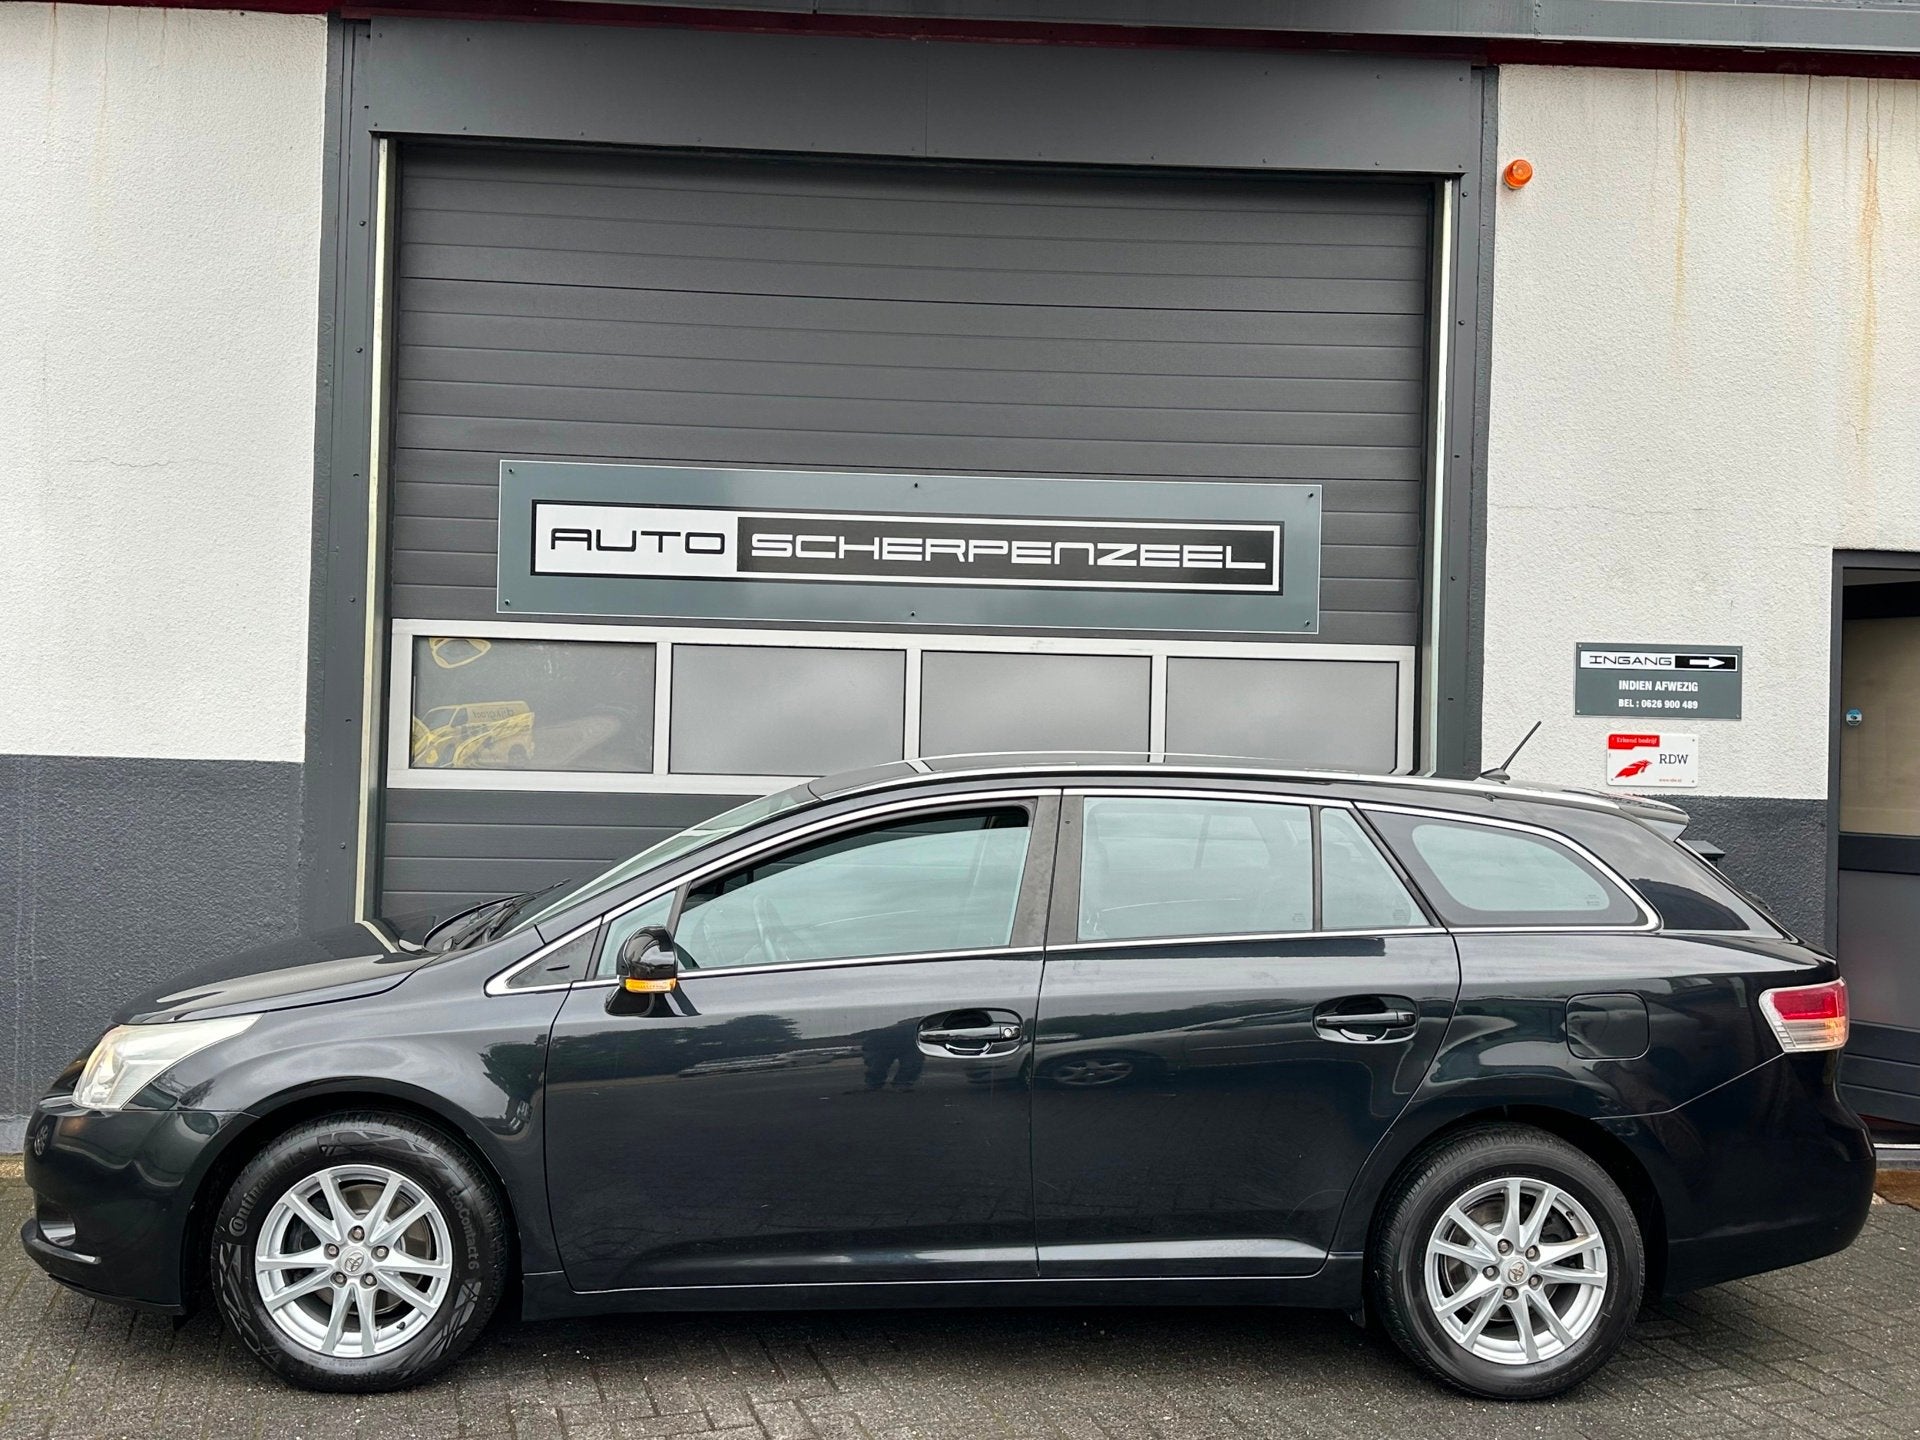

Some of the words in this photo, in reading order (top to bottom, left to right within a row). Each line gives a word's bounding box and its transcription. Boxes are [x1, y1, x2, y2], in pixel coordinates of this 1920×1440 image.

[550, 526, 726, 555] AUTO
[750, 532, 1267, 569] SCHERPENZEEL
[1589, 655, 1672, 666] INGANG
[1618, 680, 1652, 691] INDIEN
[1655, 681, 1699, 692] AFWEZIG
[1618, 699, 1634, 708] BEL
[1641, 699, 1662, 709] 0626
[1664, 700, 1680, 709] 900
[1682, 700, 1698, 709] 489
[1659, 753, 1689, 765] RDW
[446, 1186, 479, 1260] EcoContact
[468, 1260, 480, 1270] 6
